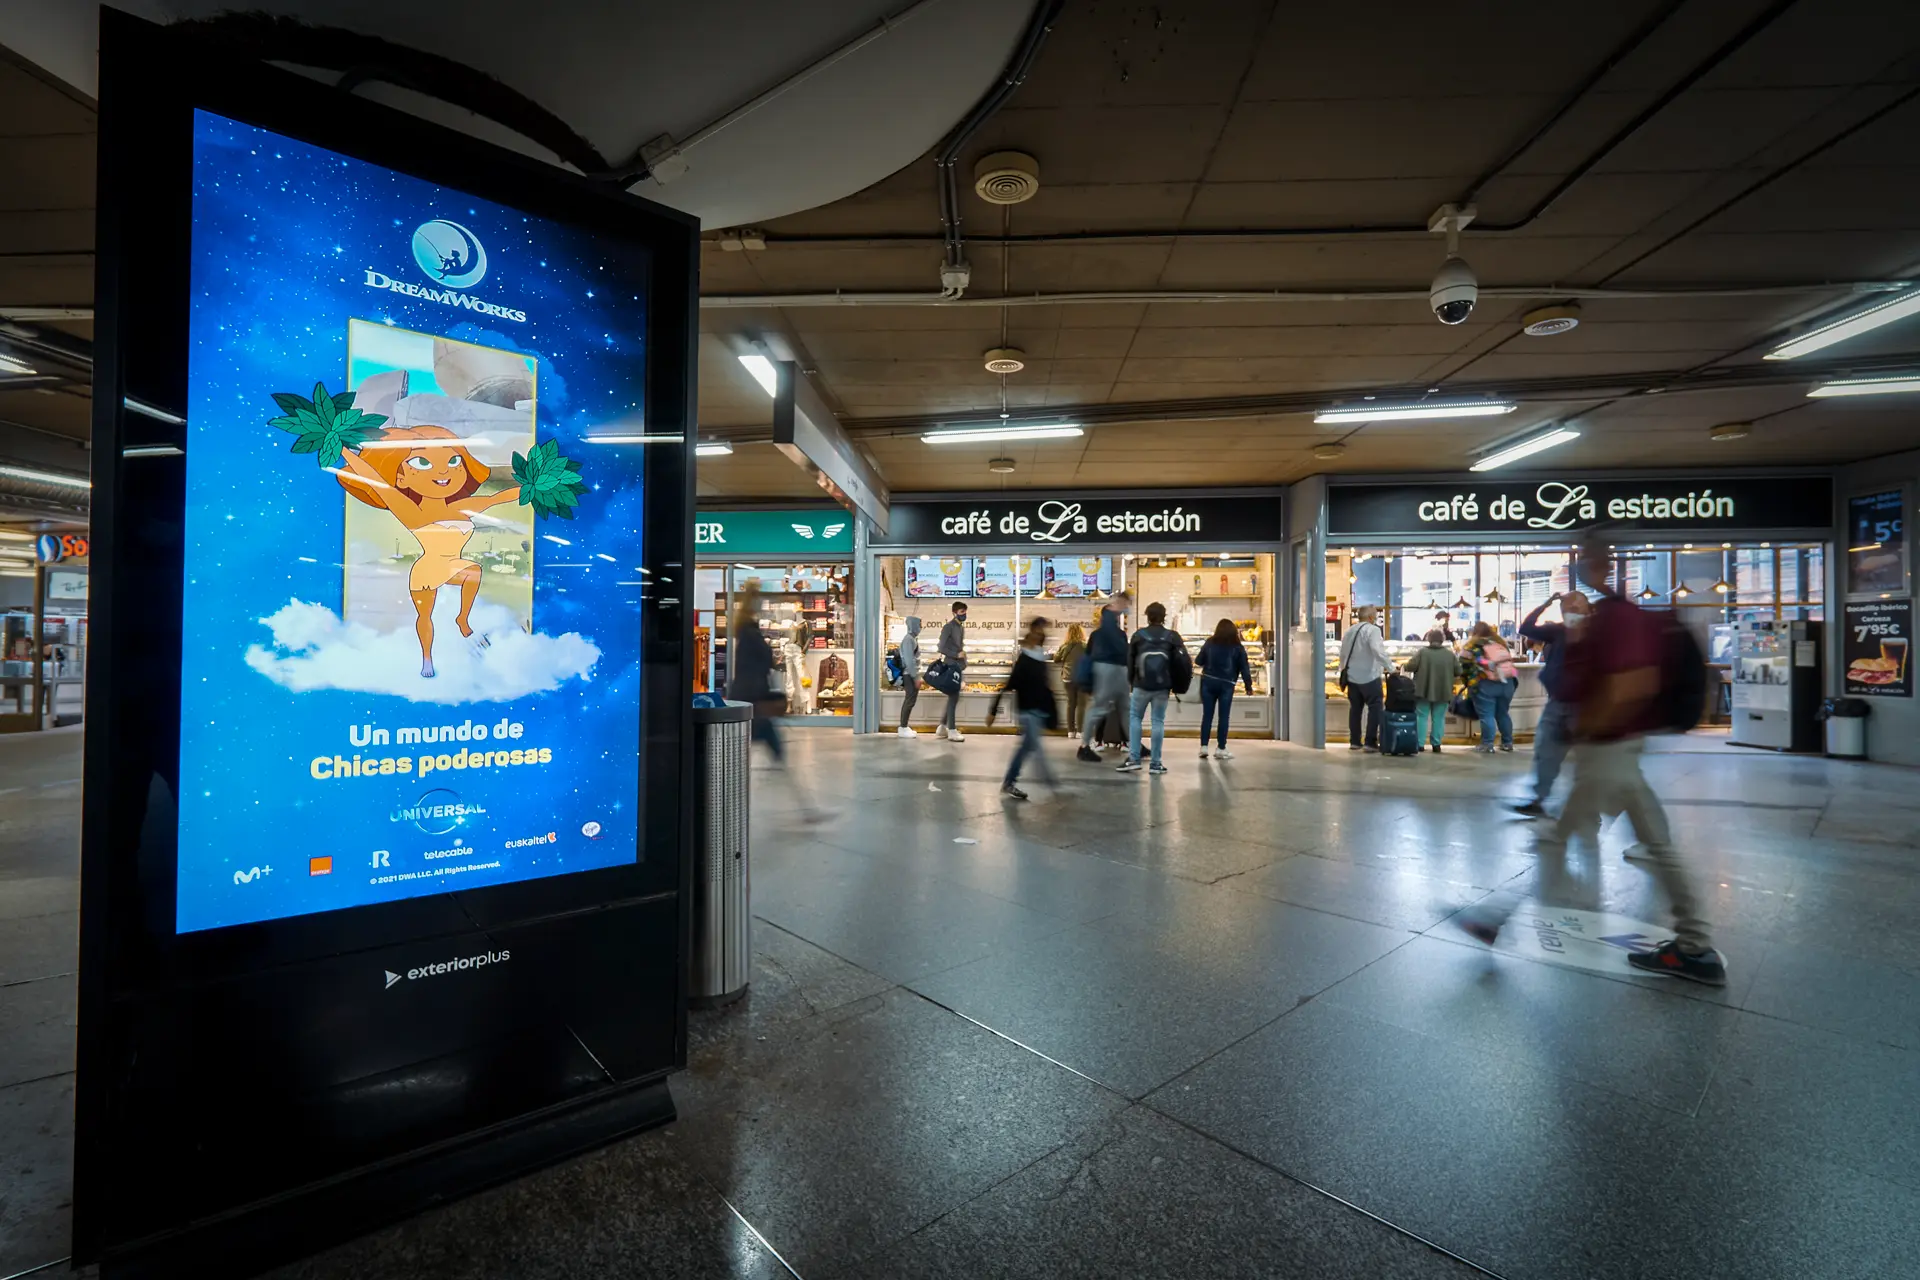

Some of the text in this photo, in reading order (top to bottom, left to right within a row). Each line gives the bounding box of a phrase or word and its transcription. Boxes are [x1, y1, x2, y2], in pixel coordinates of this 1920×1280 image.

[1418, 482, 1735, 530] café de La estación
[941, 500, 1201, 543] café de La estación
[349, 718, 524, 748] Un mundo de
[310, 747, 553, 780] Chicas poderosas
[390, 802, 487, 822] UNIVERSAL
[423, 846, 474, 860] telecable
[505, 834, 548, 849] euskaltel
[378, 874, 398, 884] 2021
[398, 872, 417, 881] DWA
[434, 867, 444, 876] All
[444, 864, 467, 875] Rights
[407, 950, 511, 980] exteriorplus
